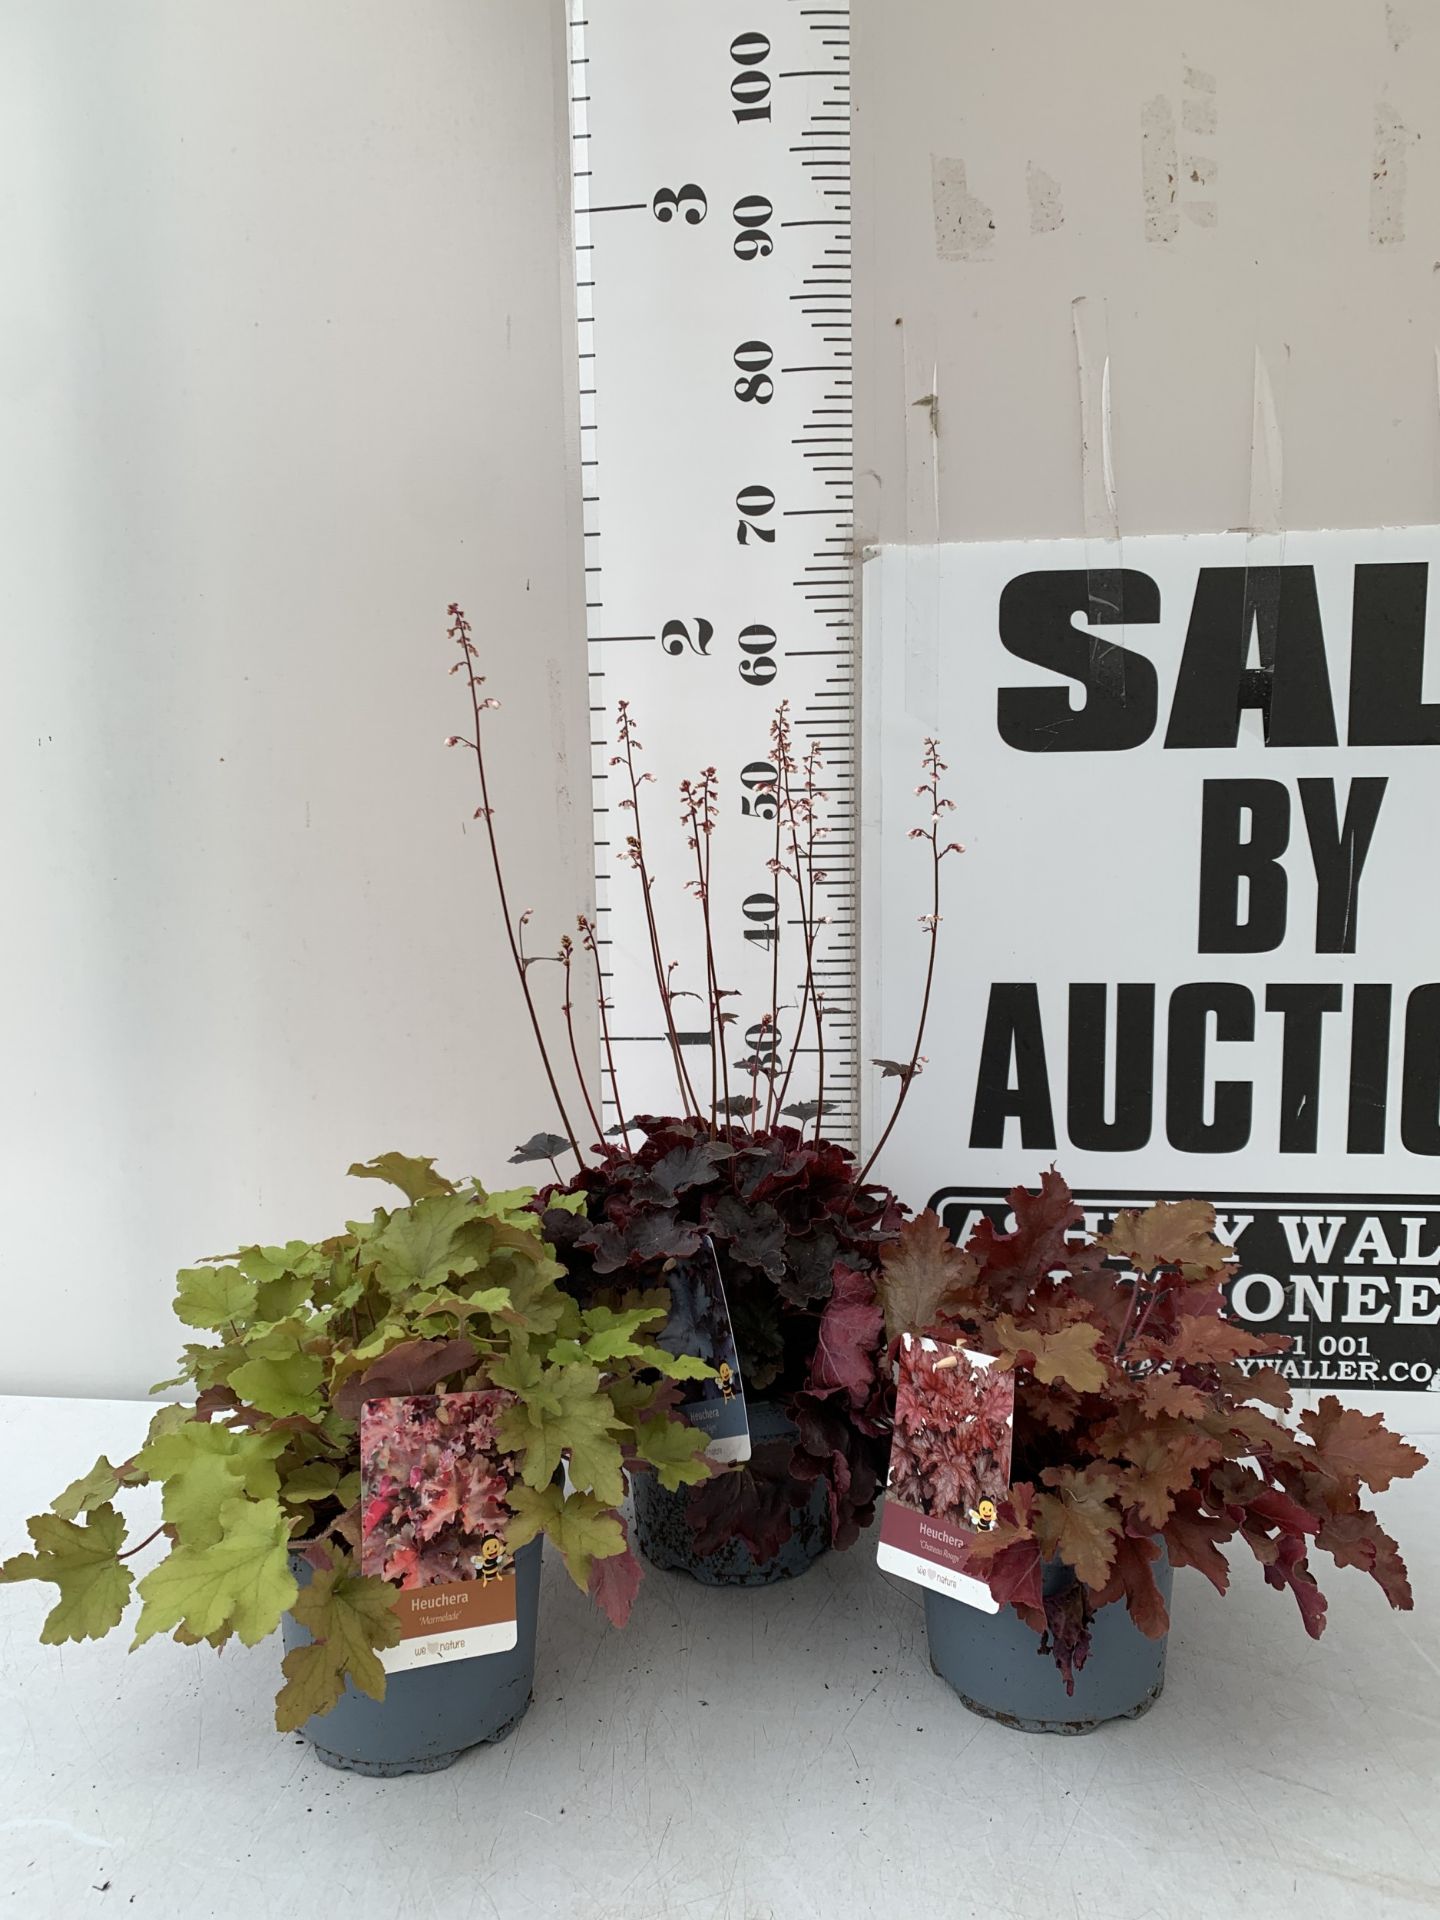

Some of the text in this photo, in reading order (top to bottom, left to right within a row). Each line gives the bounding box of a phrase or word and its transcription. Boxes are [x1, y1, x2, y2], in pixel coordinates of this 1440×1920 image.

[731, 32, 771, 124] 100
[653, 183, 708, 225] 3
[733, 195, 773, 261] 90
[733, 340, 773, 405] 80
[735, 484, 776, 546] 70
[661, 617, 714, 656] 2
[738, 623, 778, 687] 60
[996, 562, 1440, 753] SAL
[740, 762, 779, 821] 50
[1197, 776, 1389, 954] BY
[742, 893, 780, 952] 40
[1319, 1336, 1371, 1357] 001
[919, 1522, 964, 1548] Heuchera
[411, 1592, 469, 1612] Heuchera
[439, 1639, 466, 1652] nature
